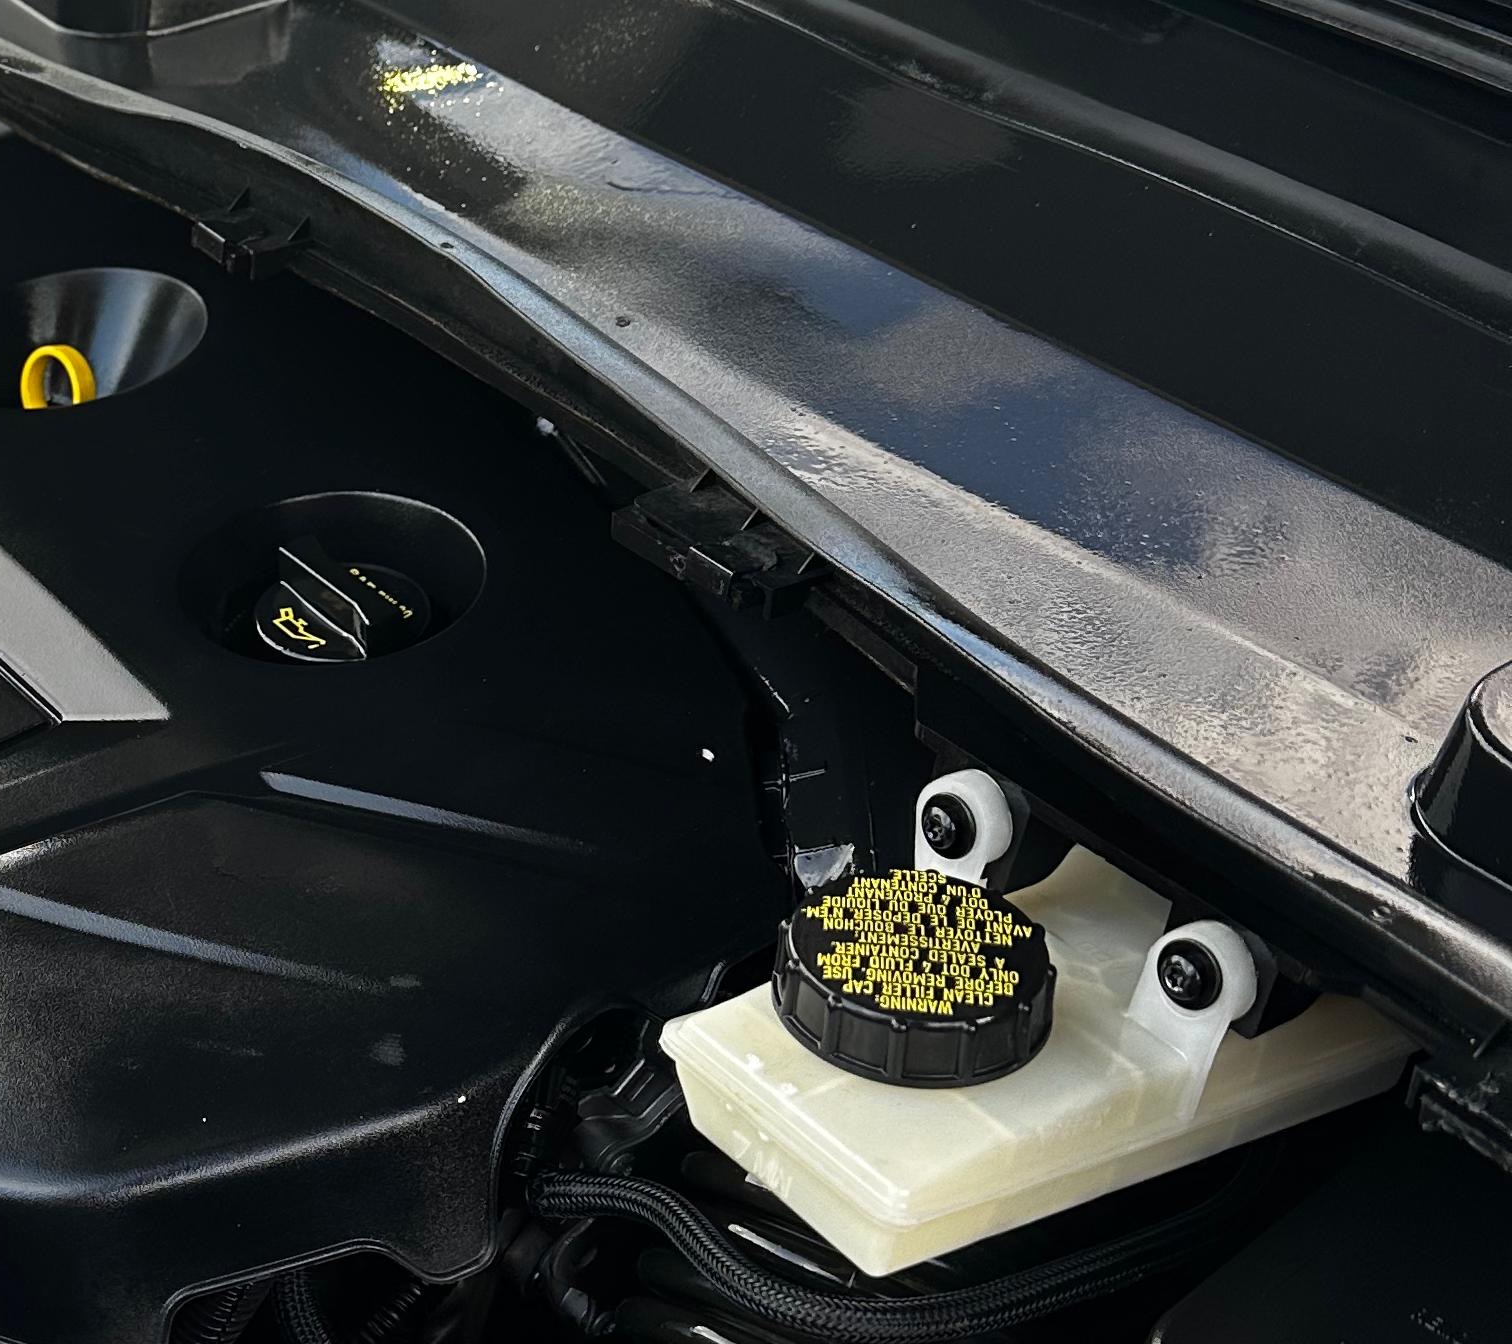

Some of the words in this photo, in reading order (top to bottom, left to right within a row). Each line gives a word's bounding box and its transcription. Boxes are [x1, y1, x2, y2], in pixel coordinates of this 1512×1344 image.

[853, 876, 937, 893] CONTENANT
[847, 886, 932, 903] PROVENANT
[941, 895, 950, 905] 4
[822, 896, 879, 911] LIQUIDE
[889, 900, 908, 913] DU
[919, 902, 946, 916] QUE
[960, 897, 988, 909] DOT
[930, 915, 947, 927] LE
[956, 906, 1012, 923] PLOYER
[823, 917, 894, 932] BOUCHON
[908, 923, 924, 935] LE
[957, 917, 975, 931] DE
[985, 921, 1032, 937] AVANT
[936, 926, 1012, 946] NETTOYER
[817, 953, 860, 967] FROM
[870, 956, 913, 973] FLUID
[929, 950, 986, 967] SEALED
[995, 957, 1005, 969] A
[822, 966, 852, 980] USE
[923, 961, 931, 972] 4
[941, 964, 970, 977] DOT
[980, 968, 1019, 983] ONLY
[842, 980, 873, 993] CAP
[882, 982, 934, 998] FILLER
[955, 977, 1013, 995] BEFORE
[943, 988, 993, 1005] CLEAN
[875, 995, 953, 1015] WARNING:
